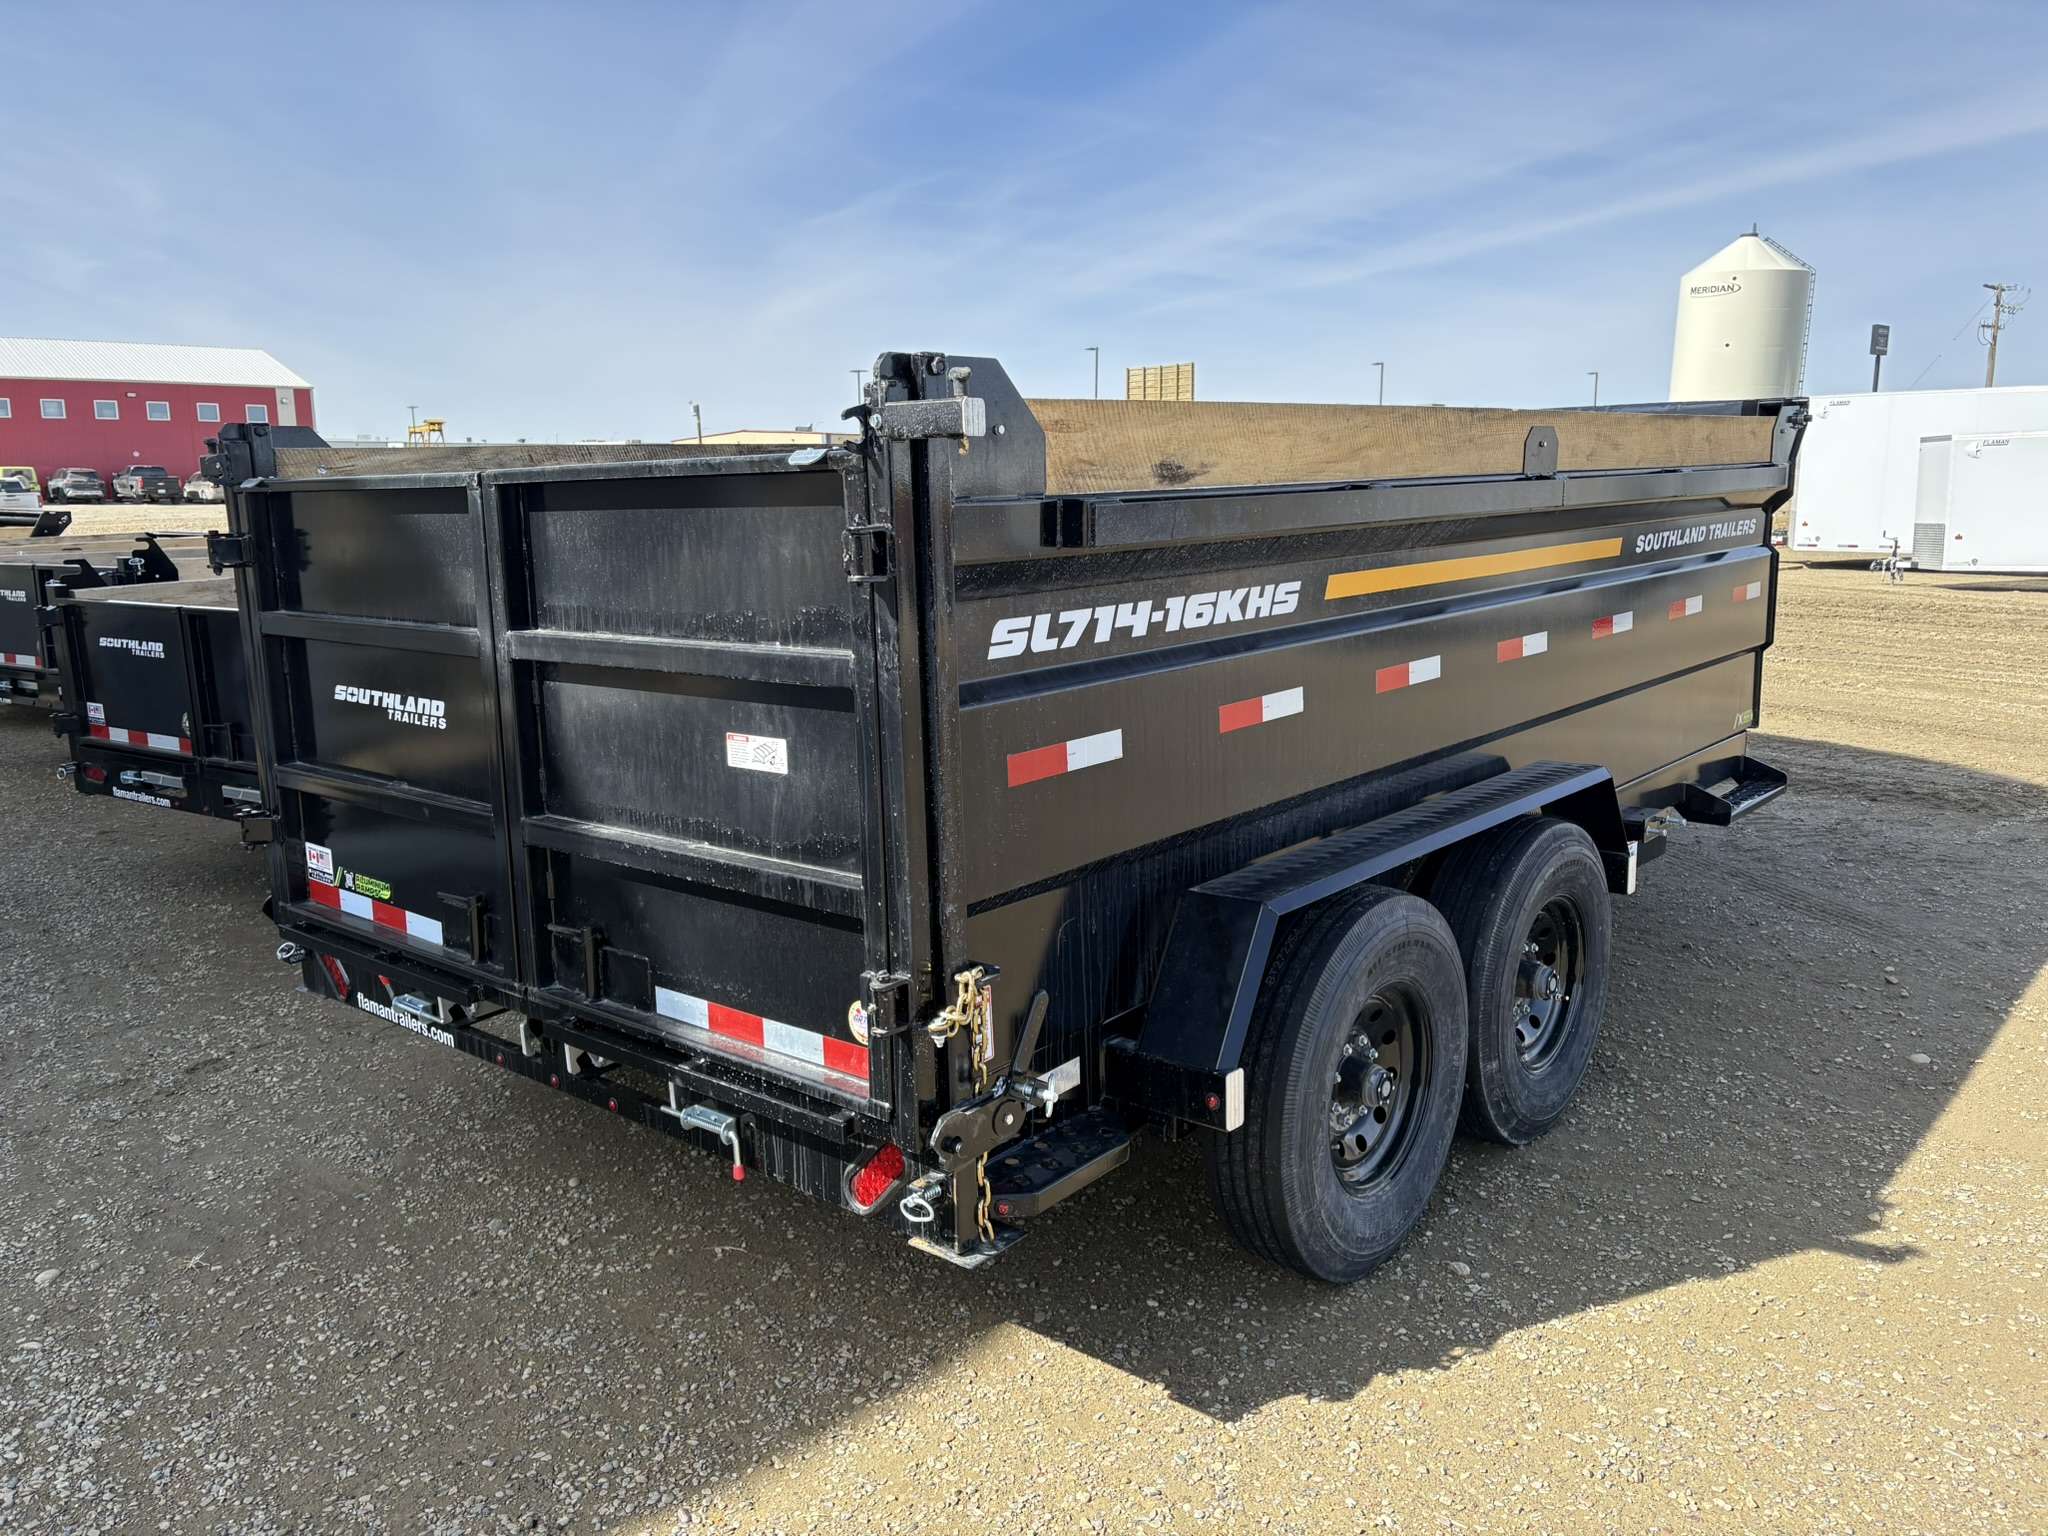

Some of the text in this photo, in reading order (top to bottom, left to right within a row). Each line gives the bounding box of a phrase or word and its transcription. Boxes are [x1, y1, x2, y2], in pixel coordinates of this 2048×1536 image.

[1690, 283, 1736, 295] MERIDIAN
[1636, 518, 1757, 553] SOUTHLAND TRAILERS
[987, 580, 1302, 660] SL714-16KHS
[99, 637, 164, 651] SOUTHLAND
[132, 649, 165, 659] TRAILERS
[334, 684, 445, 717] SOUTHLAND
[387, 709, 447, 730] TRAILERS
[357, 991, 455, 1049] flamantrailers.com
